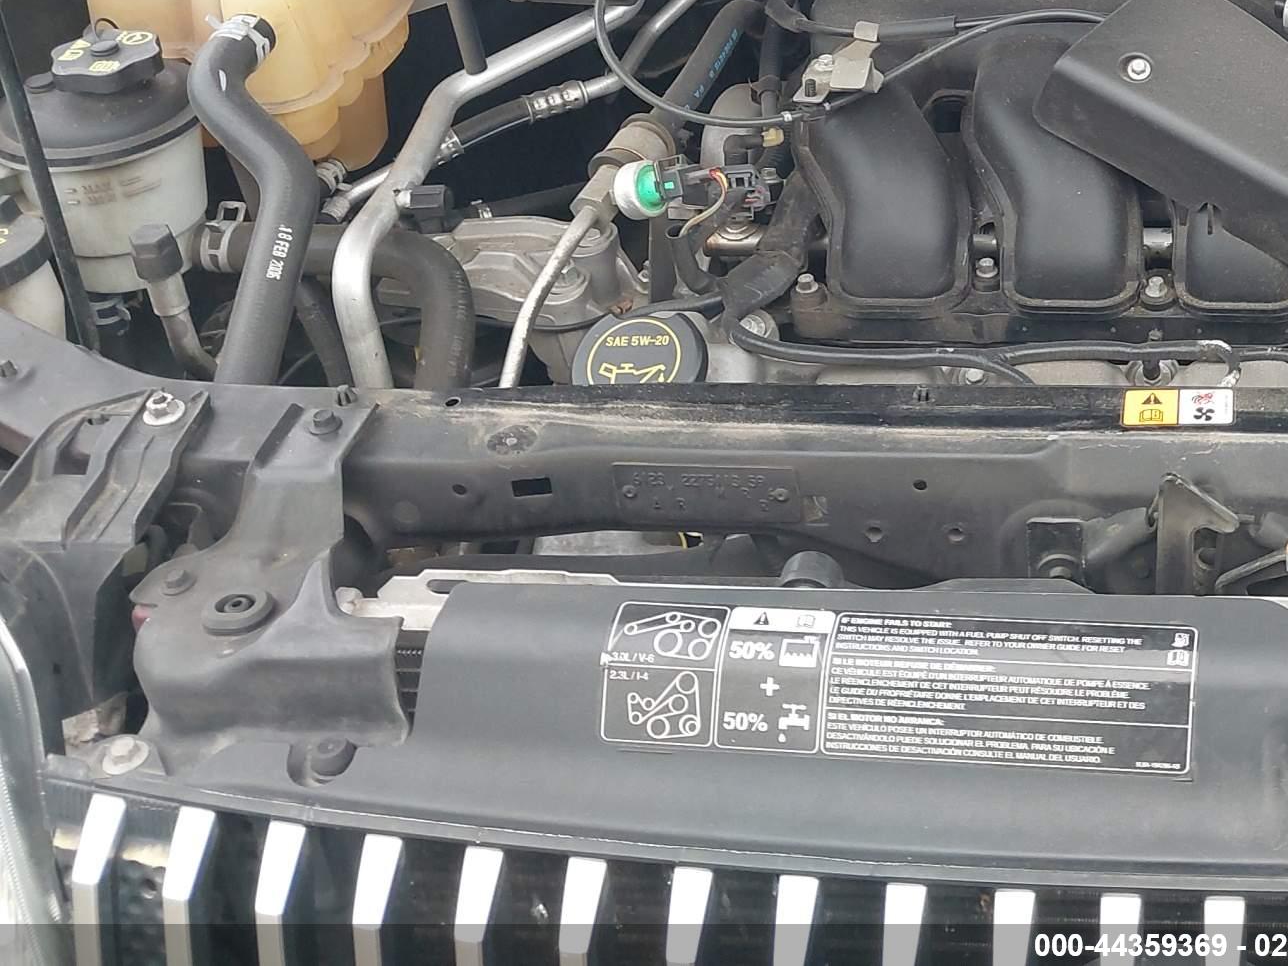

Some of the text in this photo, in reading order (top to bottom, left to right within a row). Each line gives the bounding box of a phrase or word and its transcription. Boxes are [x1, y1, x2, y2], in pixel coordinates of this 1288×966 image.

[605, 335, 670, 347] SAE 5W-20
[839, 624, 856, 632] THIS
[858, 625, 889, 634] VEHICLE
[900, 627, 937, 636] EQUIPPED
[939, 629, 958, 637] WITH
[965, 630, 986, 638] FUEL
[986, 631, 1009, 639] PUMP
[1009, 632, 1030, 640] SHUT
[1030, 633, 1048, 641] OFF
[1081, 636, 1126, 645] RESETTING
[1126, 638, 1144, 646] THE
[884, 635, 920, 644] RESOLVE
[964, 639, 990, 647] REFER
[1056, 643, 1080, 651] GUIDE
[1080, 644, 1098, 652] FOR
[1098, 645, 1126, 653] RESET
[639, 652, 655, 663] V-6
[728, 640, 775, 661] 50%
[891, 644, 908, 652] AND
[842, 657, 855, 665] LE
[610, 670, 630, 680] 2.3L
[830, 666, 843, 674] CE
[882, 669, 898, 677] EST
[948, 672, 1007, 683] INTERRUPTEUR
[1008, 675, 1062, 685] AUTOMATIQUE
[1063, 678, 1076, 686] DE
[1076, 679, 1104, 687] POMPE
[830, 676, 840, 684] LE
[919, 681, 930, 689] DE
[931, 681, 947, 690] CET
[948, 682, 1008, 693] INTERRUPTEUR
[1008, 685, 1030, 694] PEUT
[1074, 688, 1085, 697] LE
[828, 696, 874, 705] DIRECTIVES
[874, 698, 886, 706] DE
[829, 686, 840, 694] LE
[840, 687, 865, 695] GUIDE
[865, 688, 878, 696] DU
[934, 691, 962, 700] DONNE
[1027, 696, 1039, 704] DE
[1040, 696, 1056, 705] CET
[1056, 697, 1116, 708] INTERRUPTEUR
[1116, 700, 1127, 708] ET
[1128, 701, 1146, 709] DES
[723, 711, 769, 732] 50%
[827, 712, 836, 720] SI
[837, 712, 848, 720] EL
[849, 713, 882, 722] MOTOR
[883, 715, 898, 723] NO
[826, 721, 848, 730] ESTE
[887, 725, 914, 733] POSEE
[915, 726, 927, 734] UN
[927, 727, 982, 737] INTERRUPTOR
[1034, 732, 1046, 740] DE
[825, 741, 887, 752] INSTRUCCIONES
[962, 748, 1004, 758] CONSULTE
[1015, 751, 1046, 760] MANUAL
[1048, 753, 1064, 761] DEL
[895, 735, 923, 744] PUEDE
[924, 736, 973, 746] SOLUCIONAR
[974, 739, 984, 747] EL
[1030, 742, 1052, 750] PARA
[1052, 743, 1064, 751] SU
[1108, 746, 1115, 754] E
